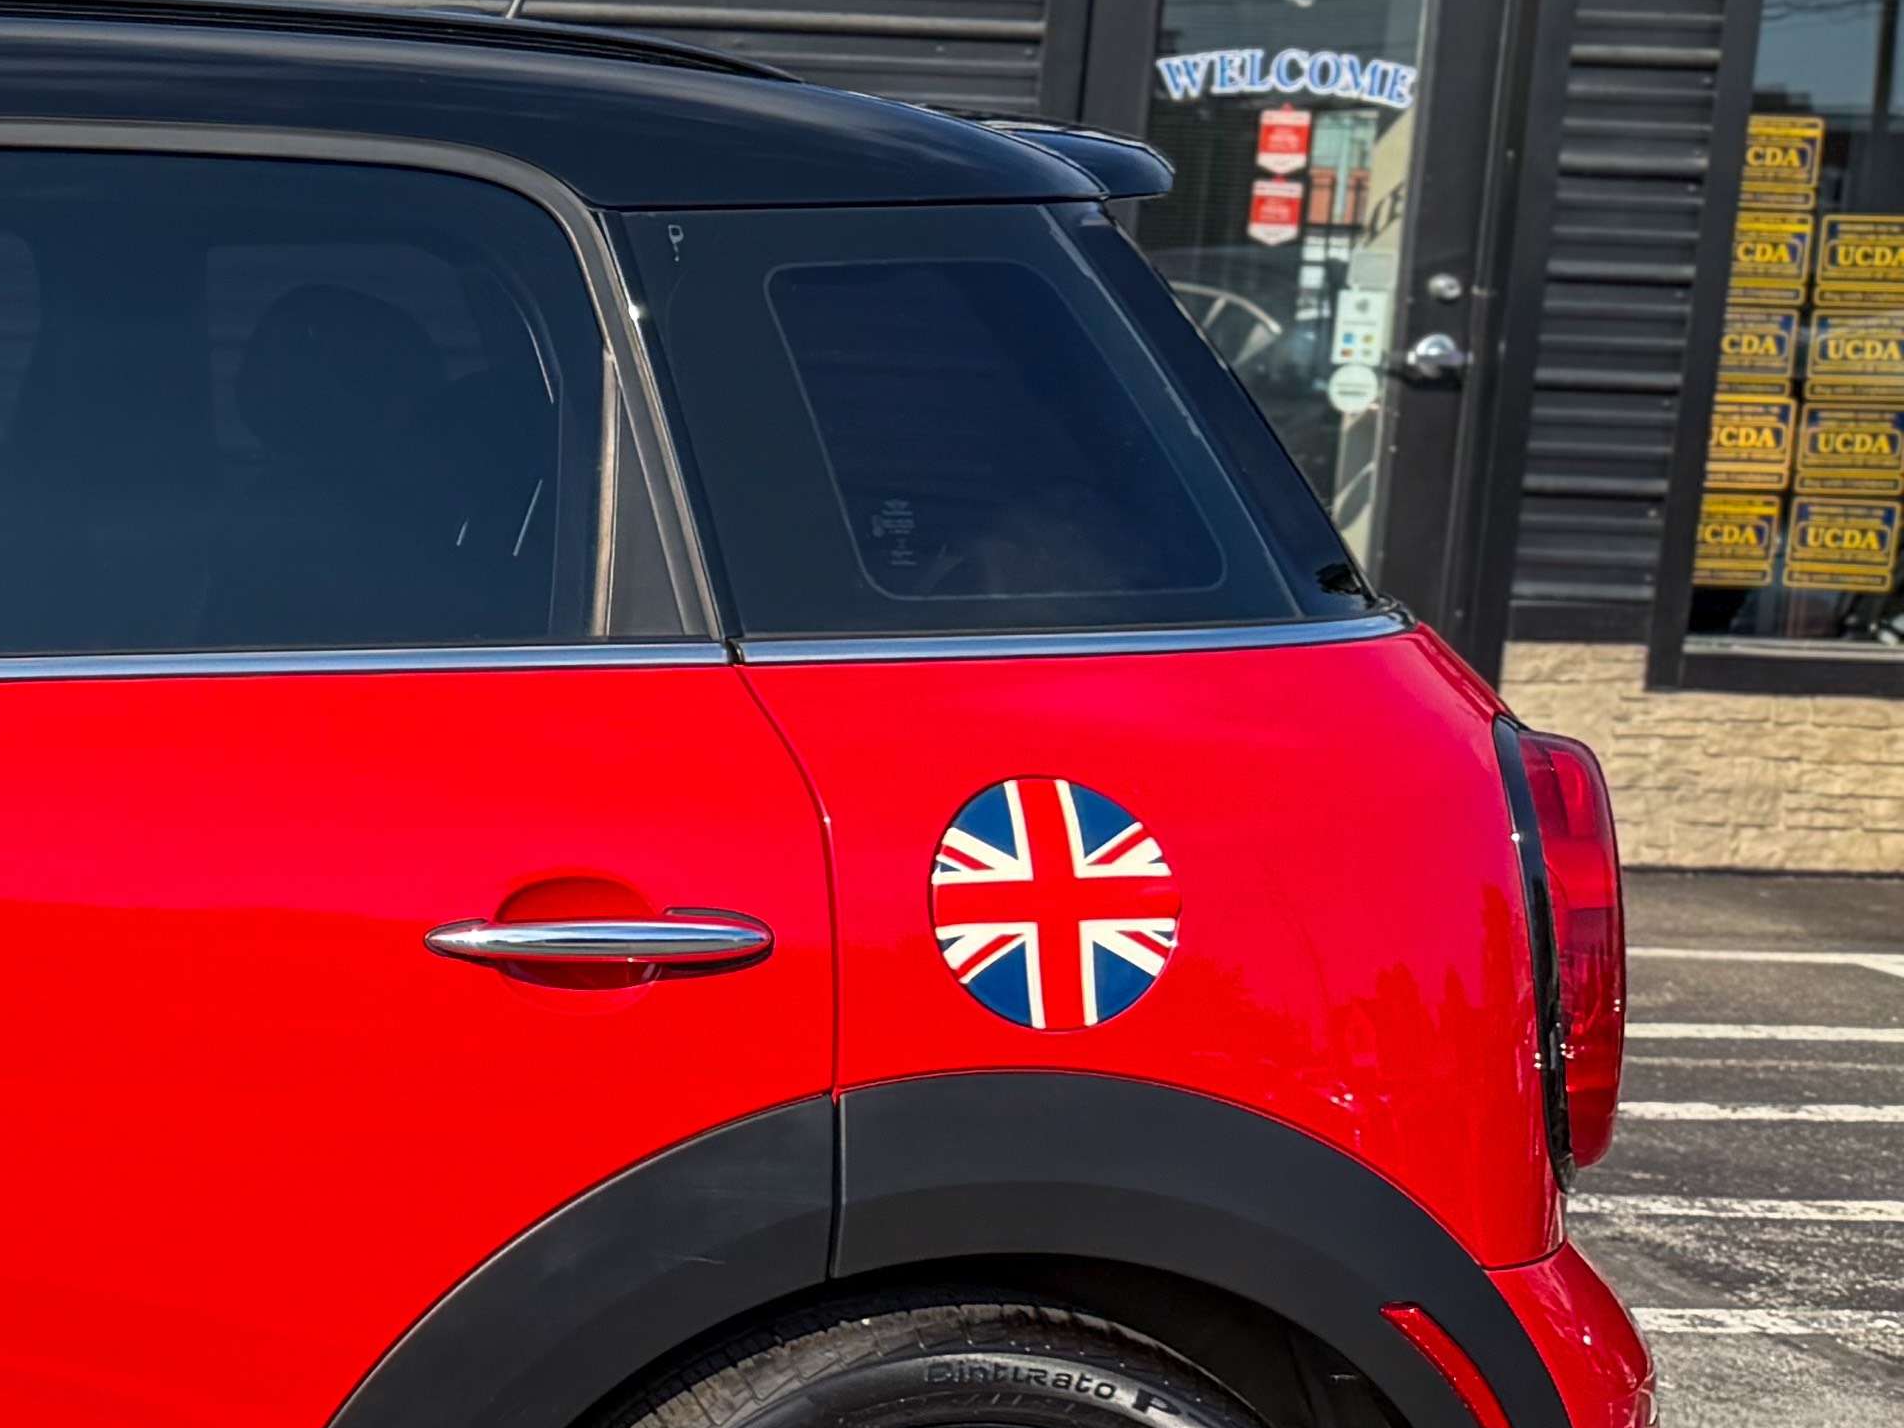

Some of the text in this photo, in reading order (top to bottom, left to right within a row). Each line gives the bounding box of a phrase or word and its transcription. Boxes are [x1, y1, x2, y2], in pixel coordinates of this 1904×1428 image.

[1156, 47, 1419, 109] WELCOME
[1745, 146, 1802, 168] CDA
[1736, 241, 1792, 263] CDA
[1836, 245, 1904, 267] UCDA
[1720, 334, 1778, 355] CDA
[1827, 339, 1901, 361] UCDA
[1817, 432, 1891, 454] UCDA
[1700, 523, 1759, 545] CDA
[1805, 526, 1881, 551] UCDA
